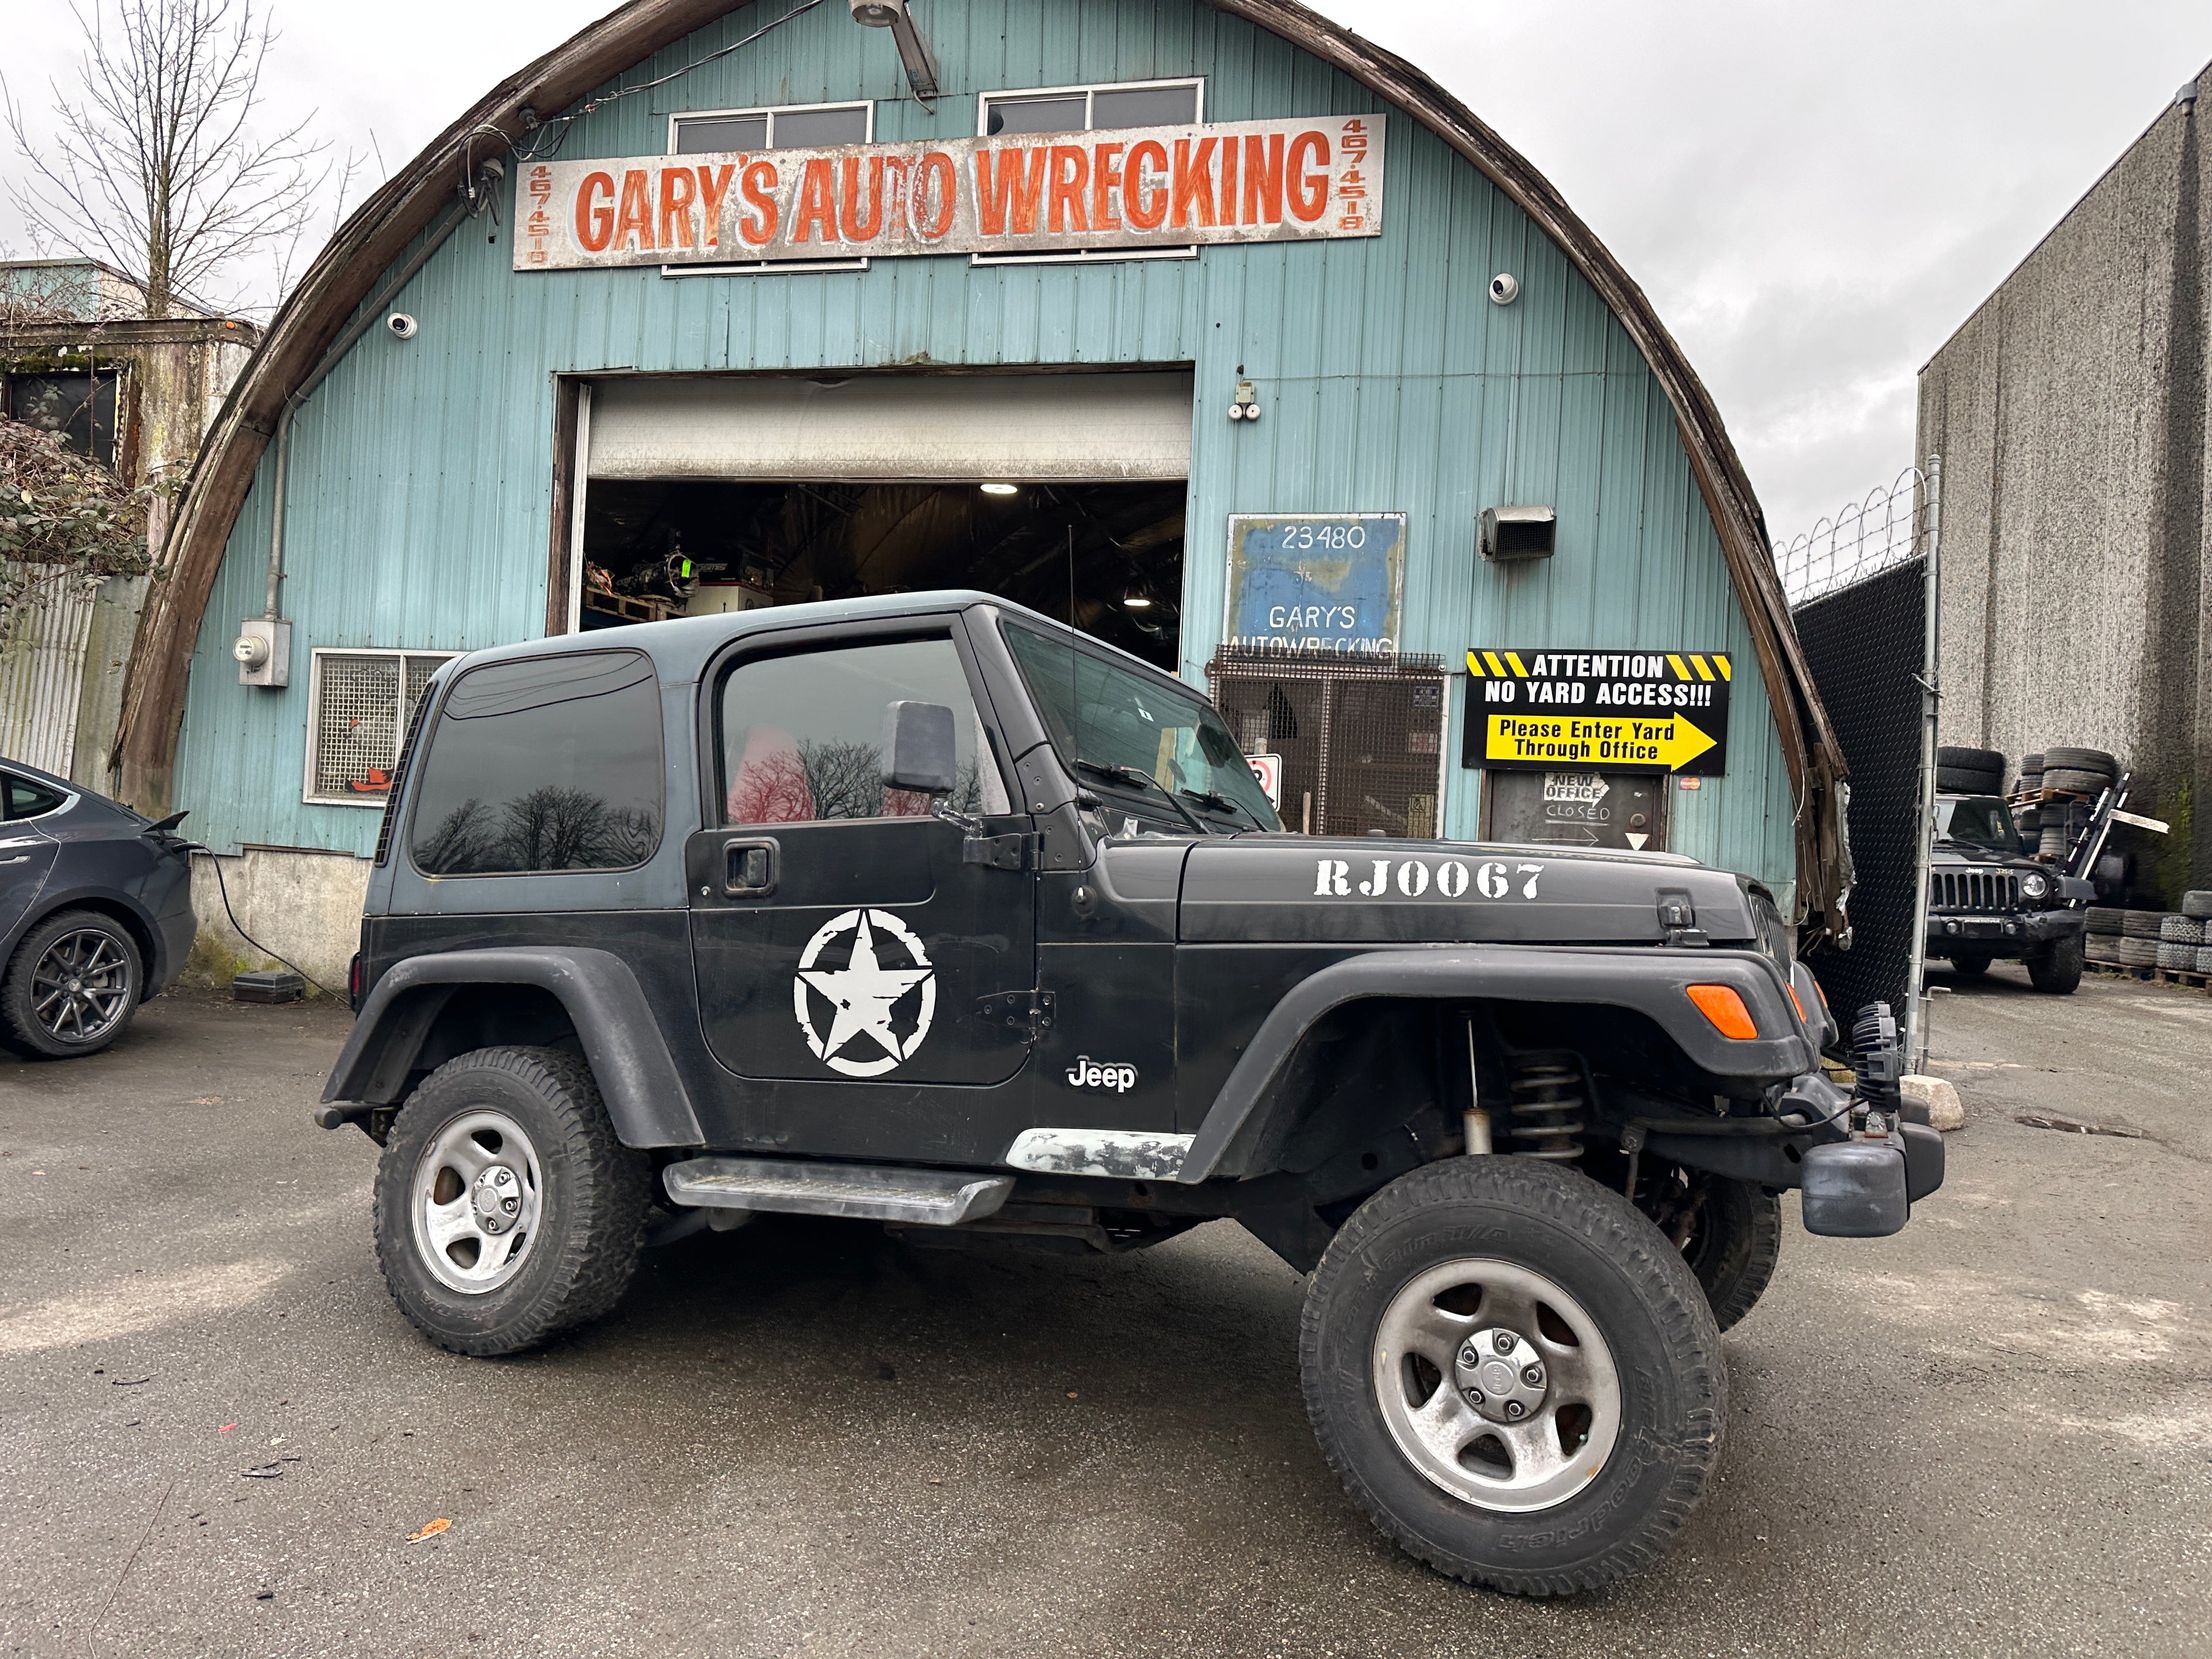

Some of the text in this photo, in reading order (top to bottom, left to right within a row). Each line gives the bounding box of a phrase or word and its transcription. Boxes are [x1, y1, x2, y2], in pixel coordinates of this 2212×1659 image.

[576, 130, 1331, 252] GARY'S AUTO WRECKING
[1282, 525, 1366, 549] 23480
[1269, 605, 1355, 629] GARY'S
[1532, 654, 1664, 678] ATTENTION
[1485, 681, 1711, 707] NO YARD ACCESS!!!
[1500, 719, 1675, 740] Please Enter Yard
[1514, 738, 1658, 760] Through Office
[1546, 785, 1601, 799] OFFICE
[1554, 774, 1593, 786] NEW
[1546, 805, 1610, 820] CLOSED
[1068, 1060, 1135, 1093] Jeep
